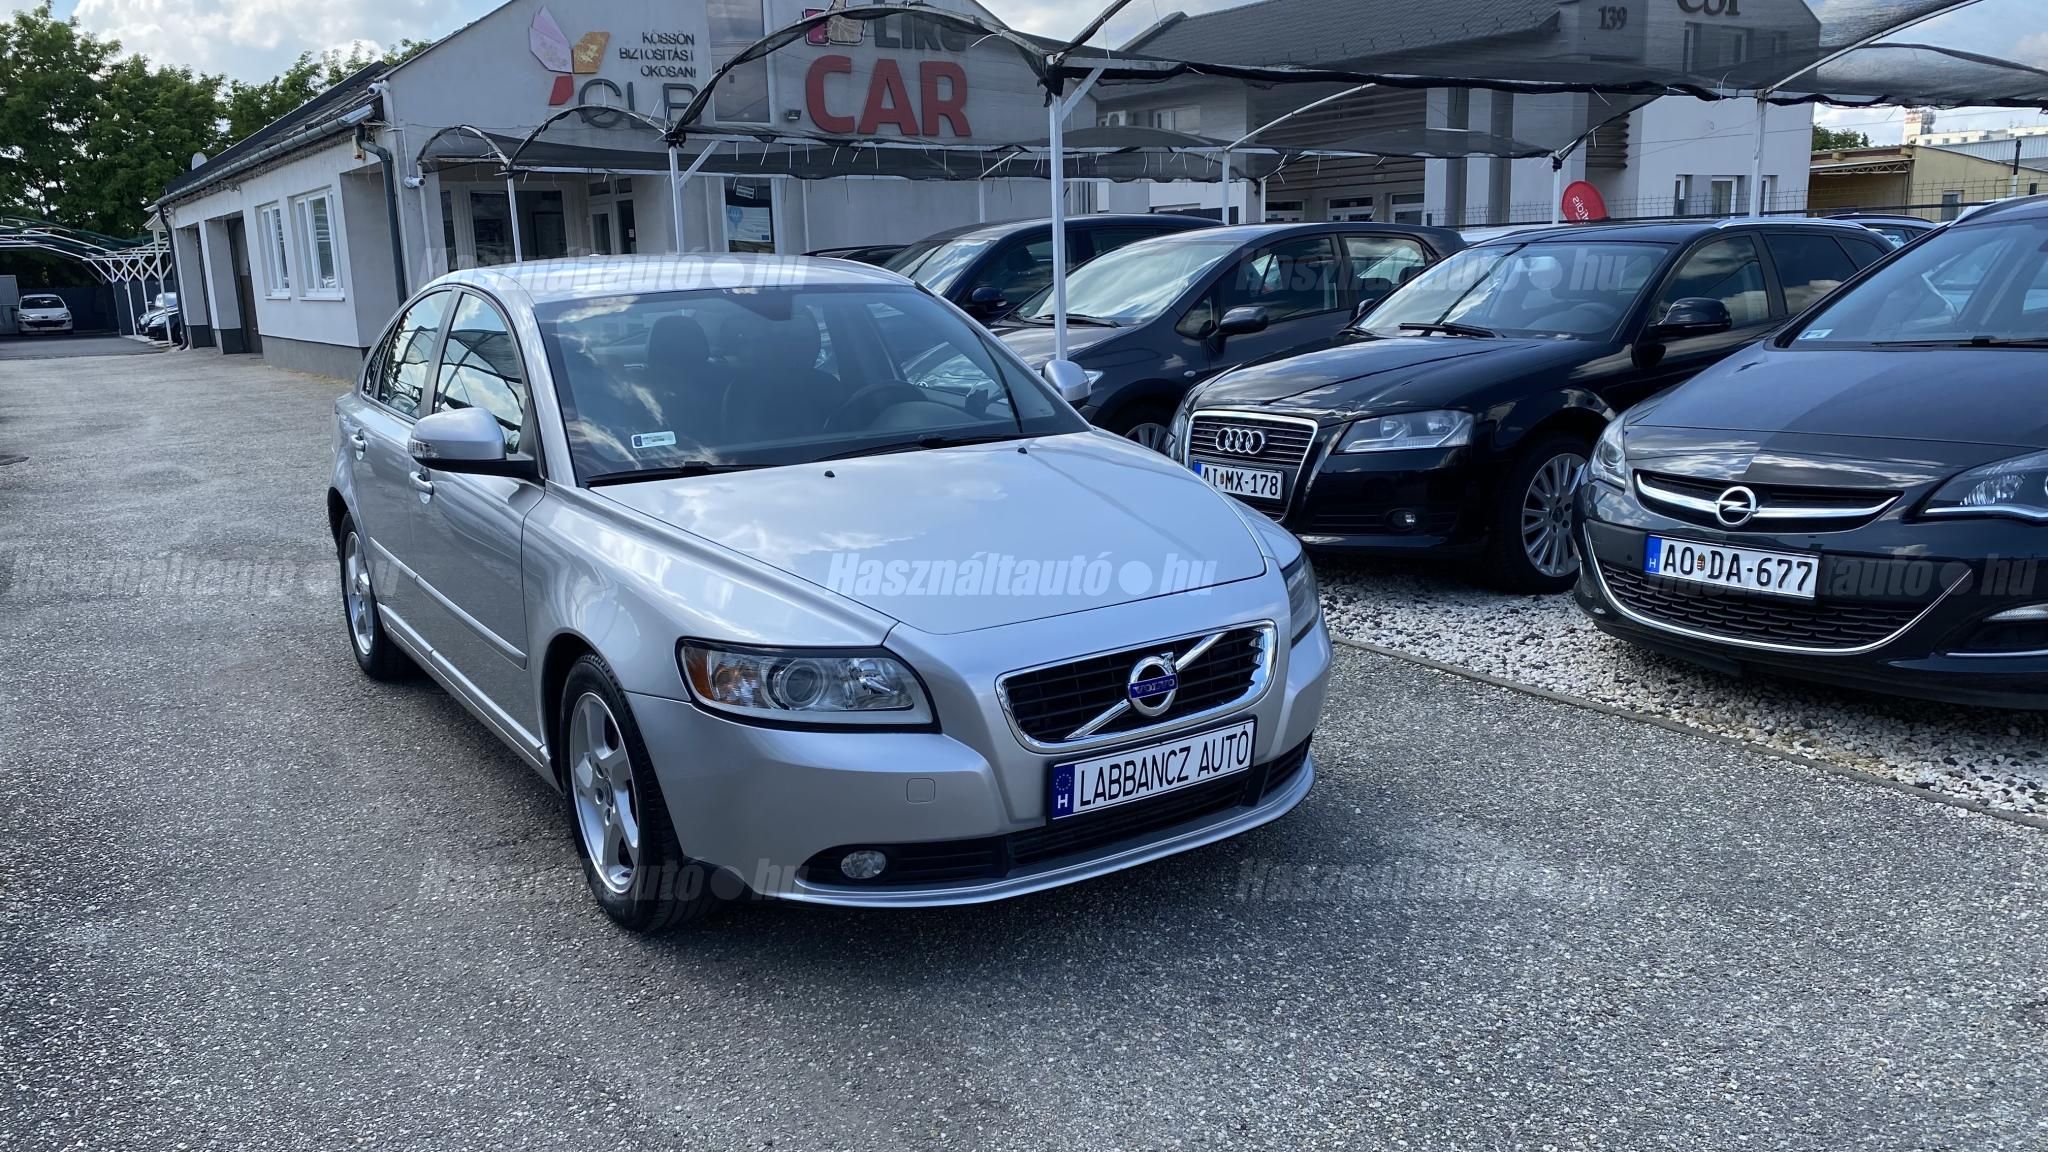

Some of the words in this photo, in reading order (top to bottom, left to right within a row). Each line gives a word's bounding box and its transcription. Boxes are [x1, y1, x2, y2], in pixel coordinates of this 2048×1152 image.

[1597, 6, 1628, 30] 139
[642, 30, 695, 45] KÖSSÖN
[640, 65, 696, 78] OKOSAN!
[805, 55, 972, 137] CAR
[1224, 469, 1279, 496] MX-178
[1663, 543, 1695, 576] AO
[1707, 550, 1813, 592] DA-677
[1132, 678, 1175, 695] VOLVO
[1057, 793, 1069, 809] H
[1079, 745, 1192, 807] LABBANCZ
[1196, 724, 1249, 778] AUTÓ
